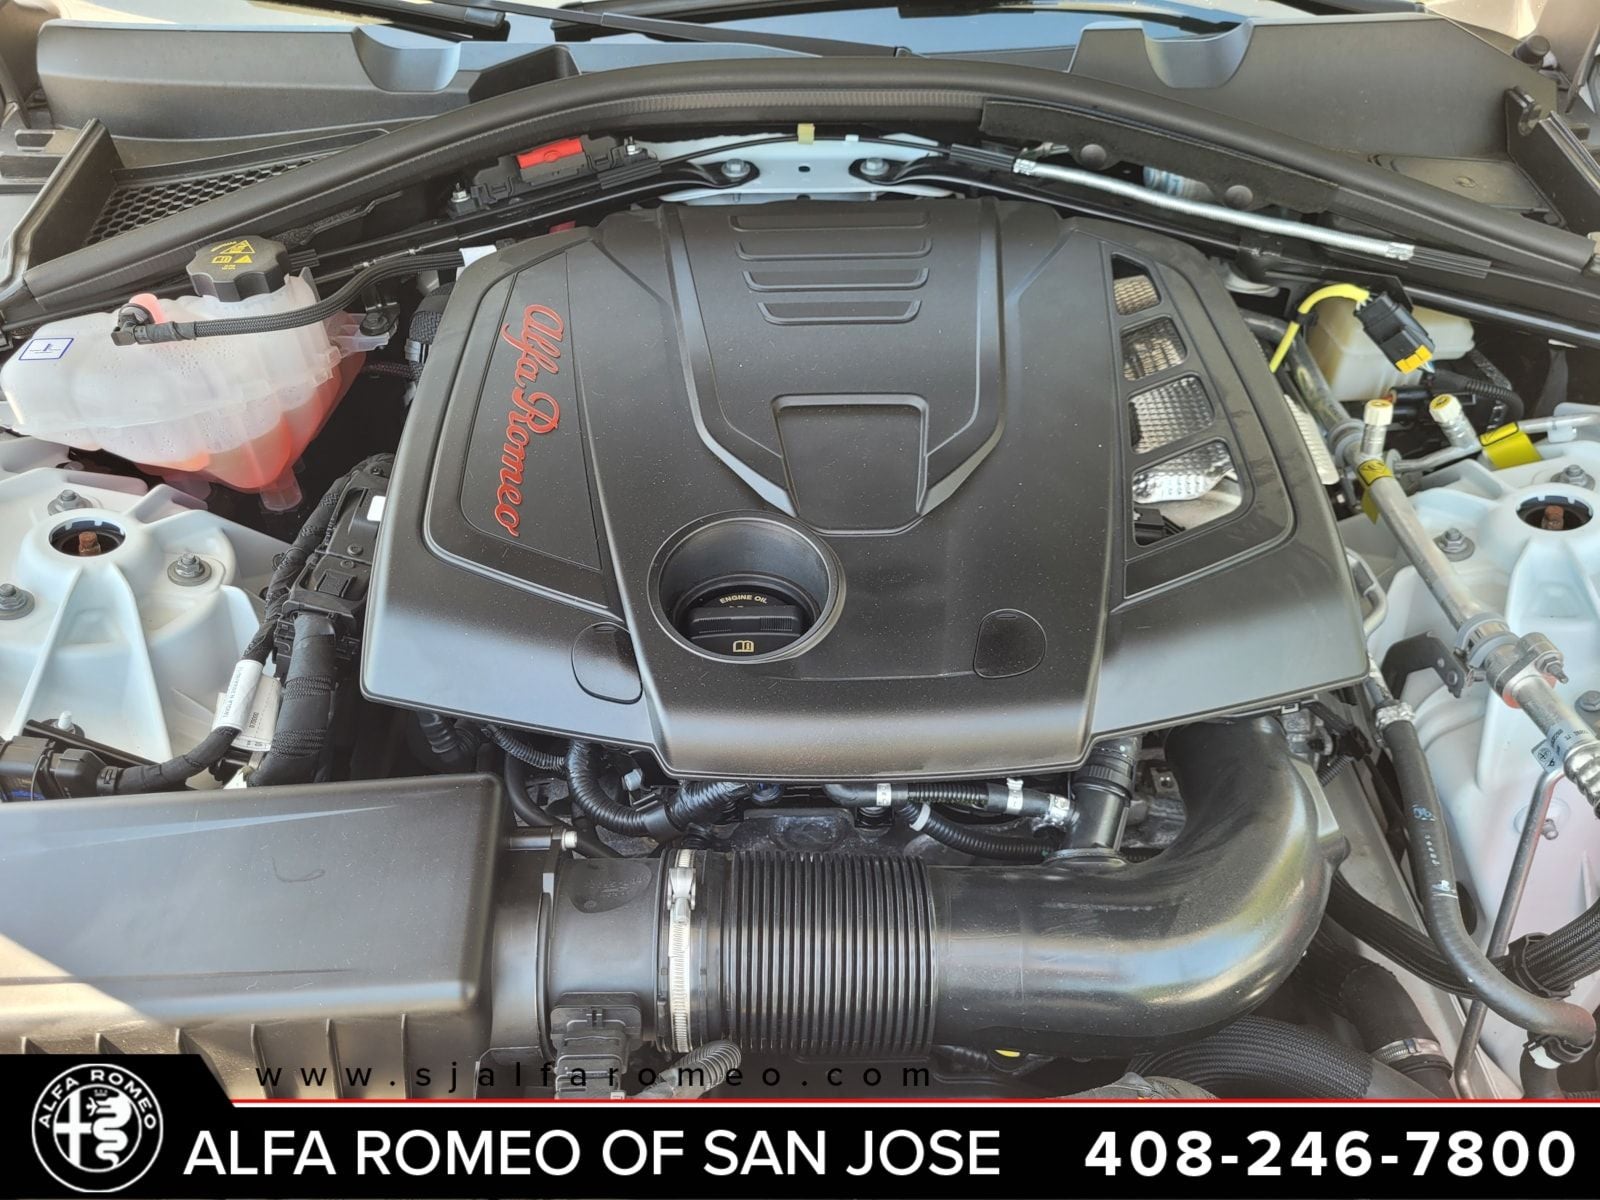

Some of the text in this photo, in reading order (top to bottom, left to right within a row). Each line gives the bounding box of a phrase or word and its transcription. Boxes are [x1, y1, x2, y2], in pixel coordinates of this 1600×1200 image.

[494, 304, 564, 538] Alfa Romeo
[719, 594, 768, 605] ENGINE OIL
